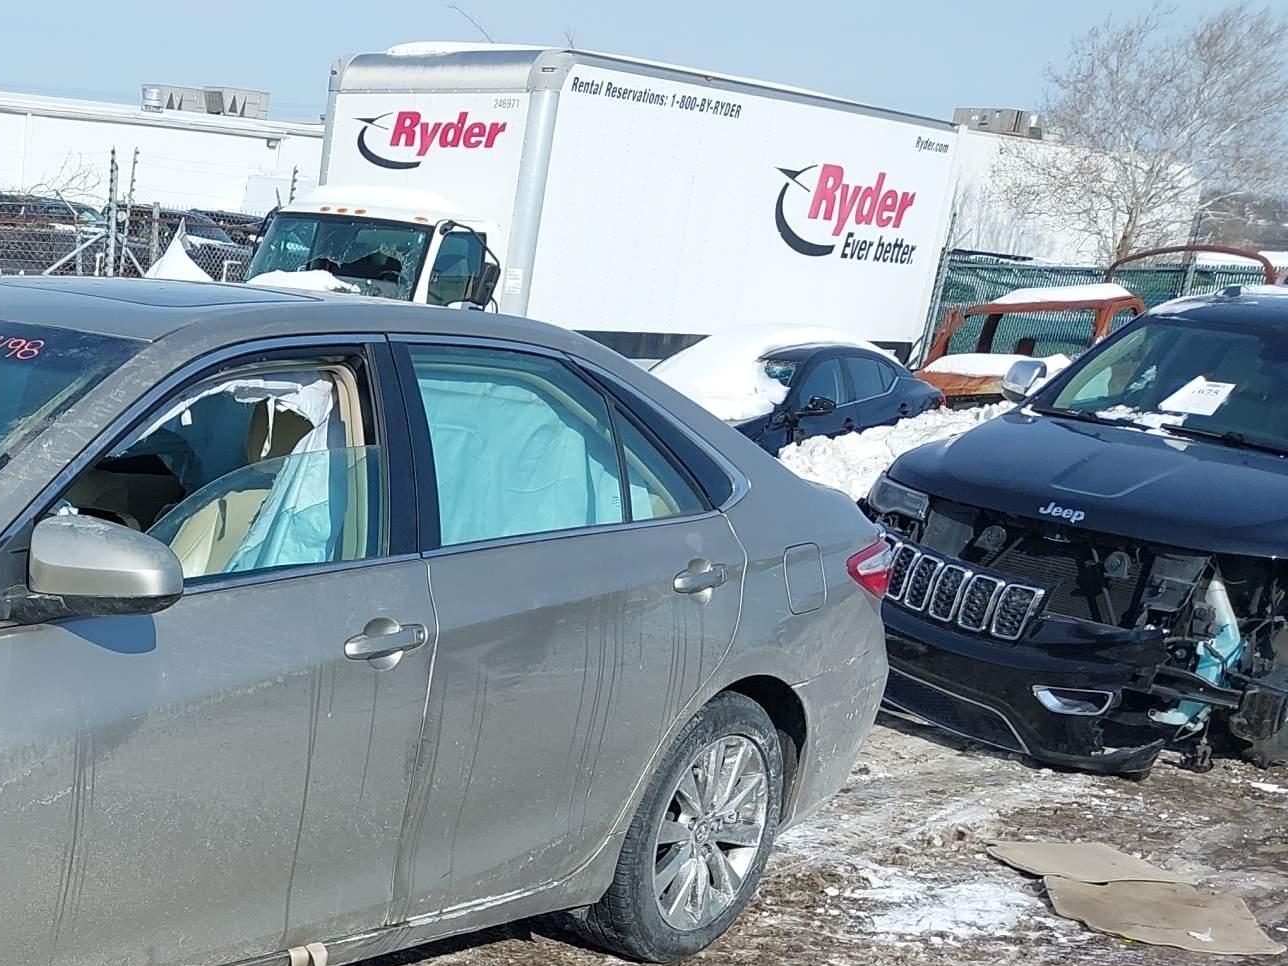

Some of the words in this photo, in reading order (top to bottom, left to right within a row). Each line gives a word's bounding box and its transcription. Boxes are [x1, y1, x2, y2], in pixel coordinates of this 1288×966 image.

[571, 76, 603, 96] Rental
[604, 82, 669, 107] Reservations:
[670, 93, 742, 119] 1-800-BY-RYDER
[389, 111, 508, 157] Ryder
[915, 136, 950, 154] Ryder.com
[808, 163, 917, 237] Ryder
[840, 232, 874, 261] Ever
[873, 235, 917, 265] better.
[1038, 501, 1086, 523] Jeep
